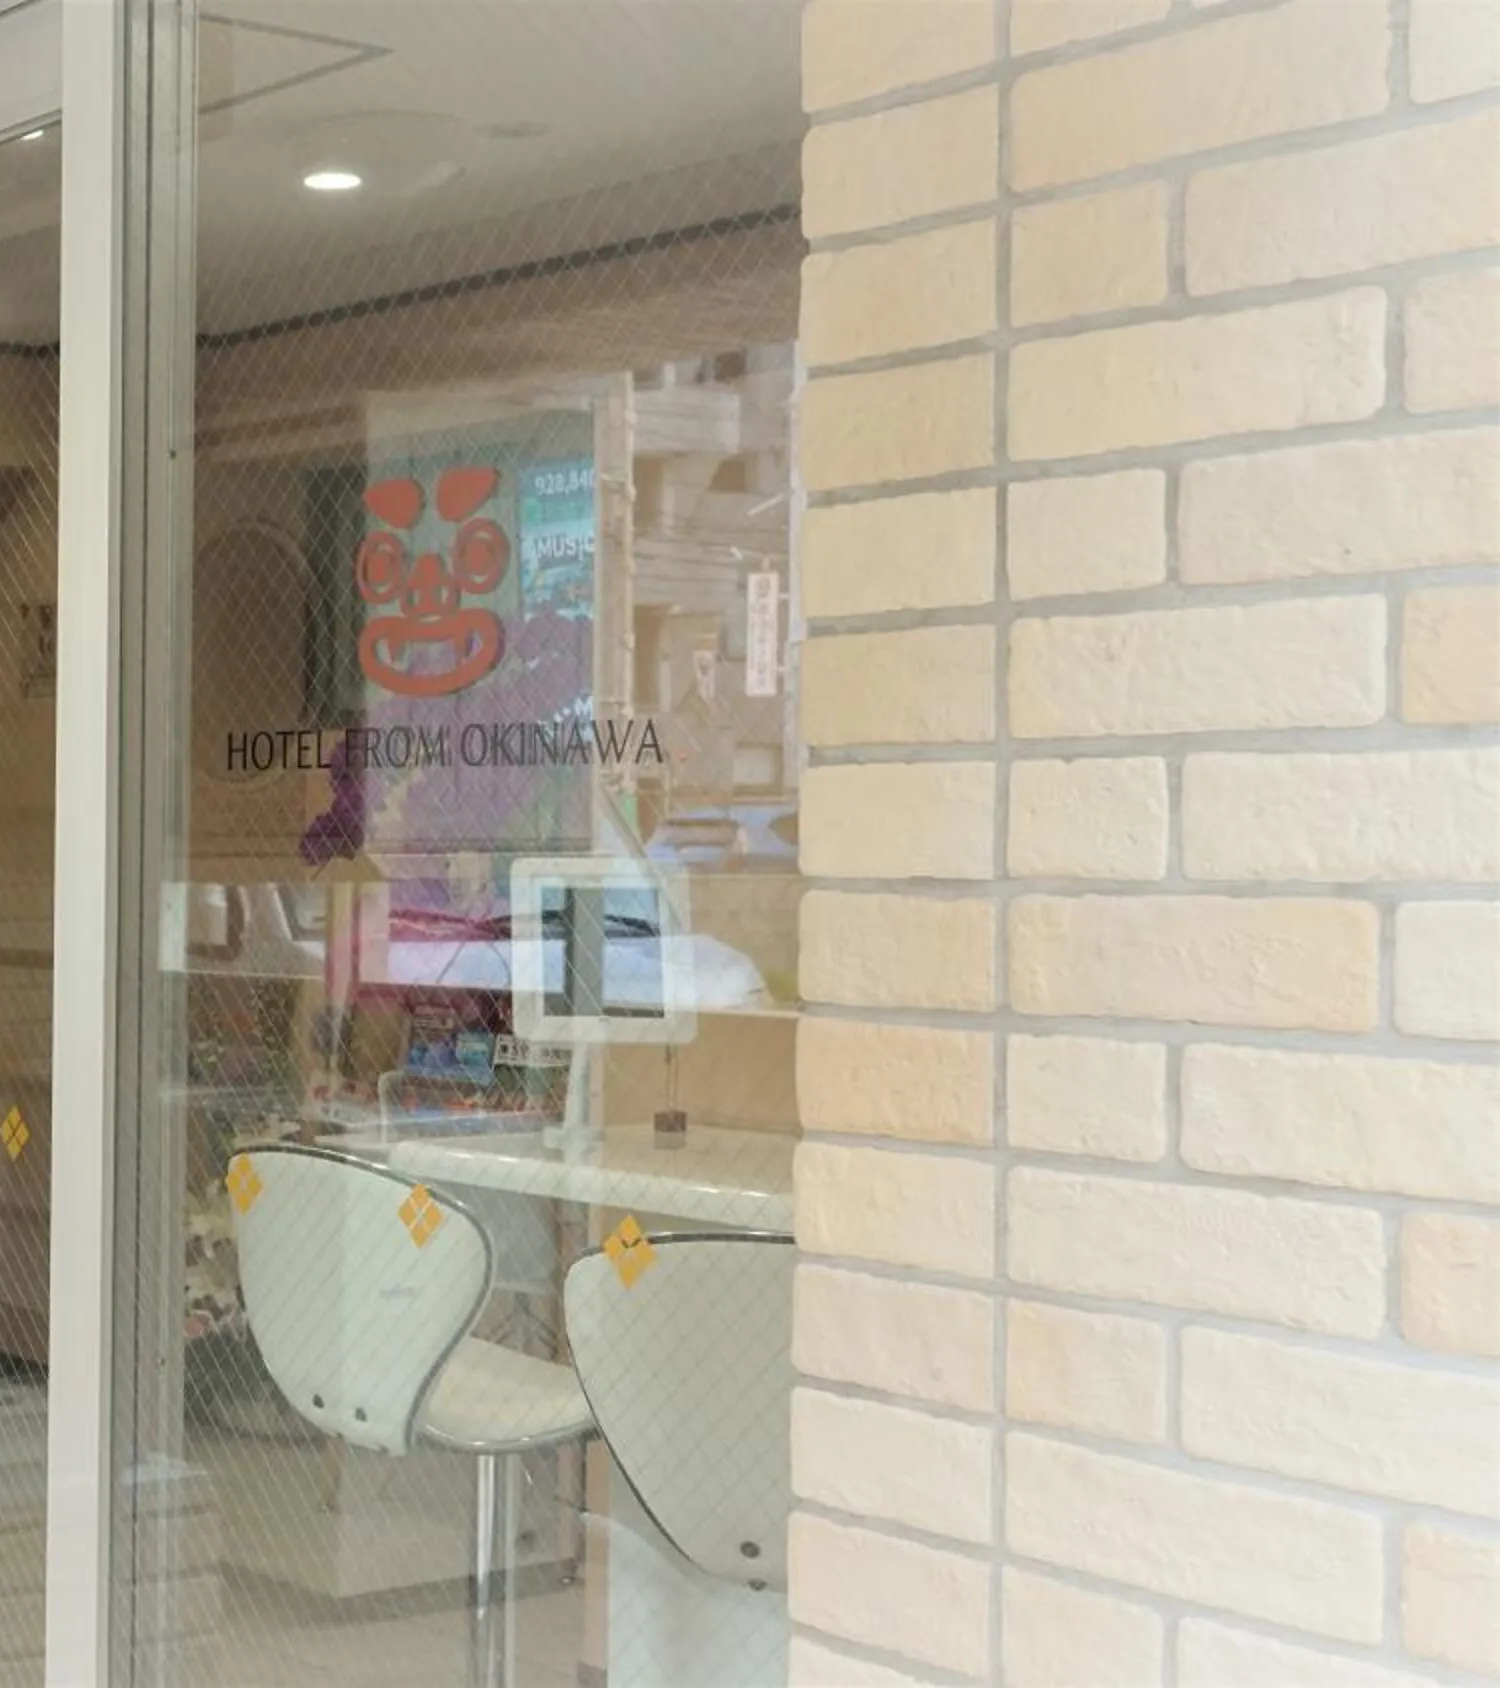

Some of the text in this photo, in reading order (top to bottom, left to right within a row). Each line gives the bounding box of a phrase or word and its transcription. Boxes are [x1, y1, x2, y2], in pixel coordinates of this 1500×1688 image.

[226, 716, 664, 771] HOTEL FROM OKINAWA
